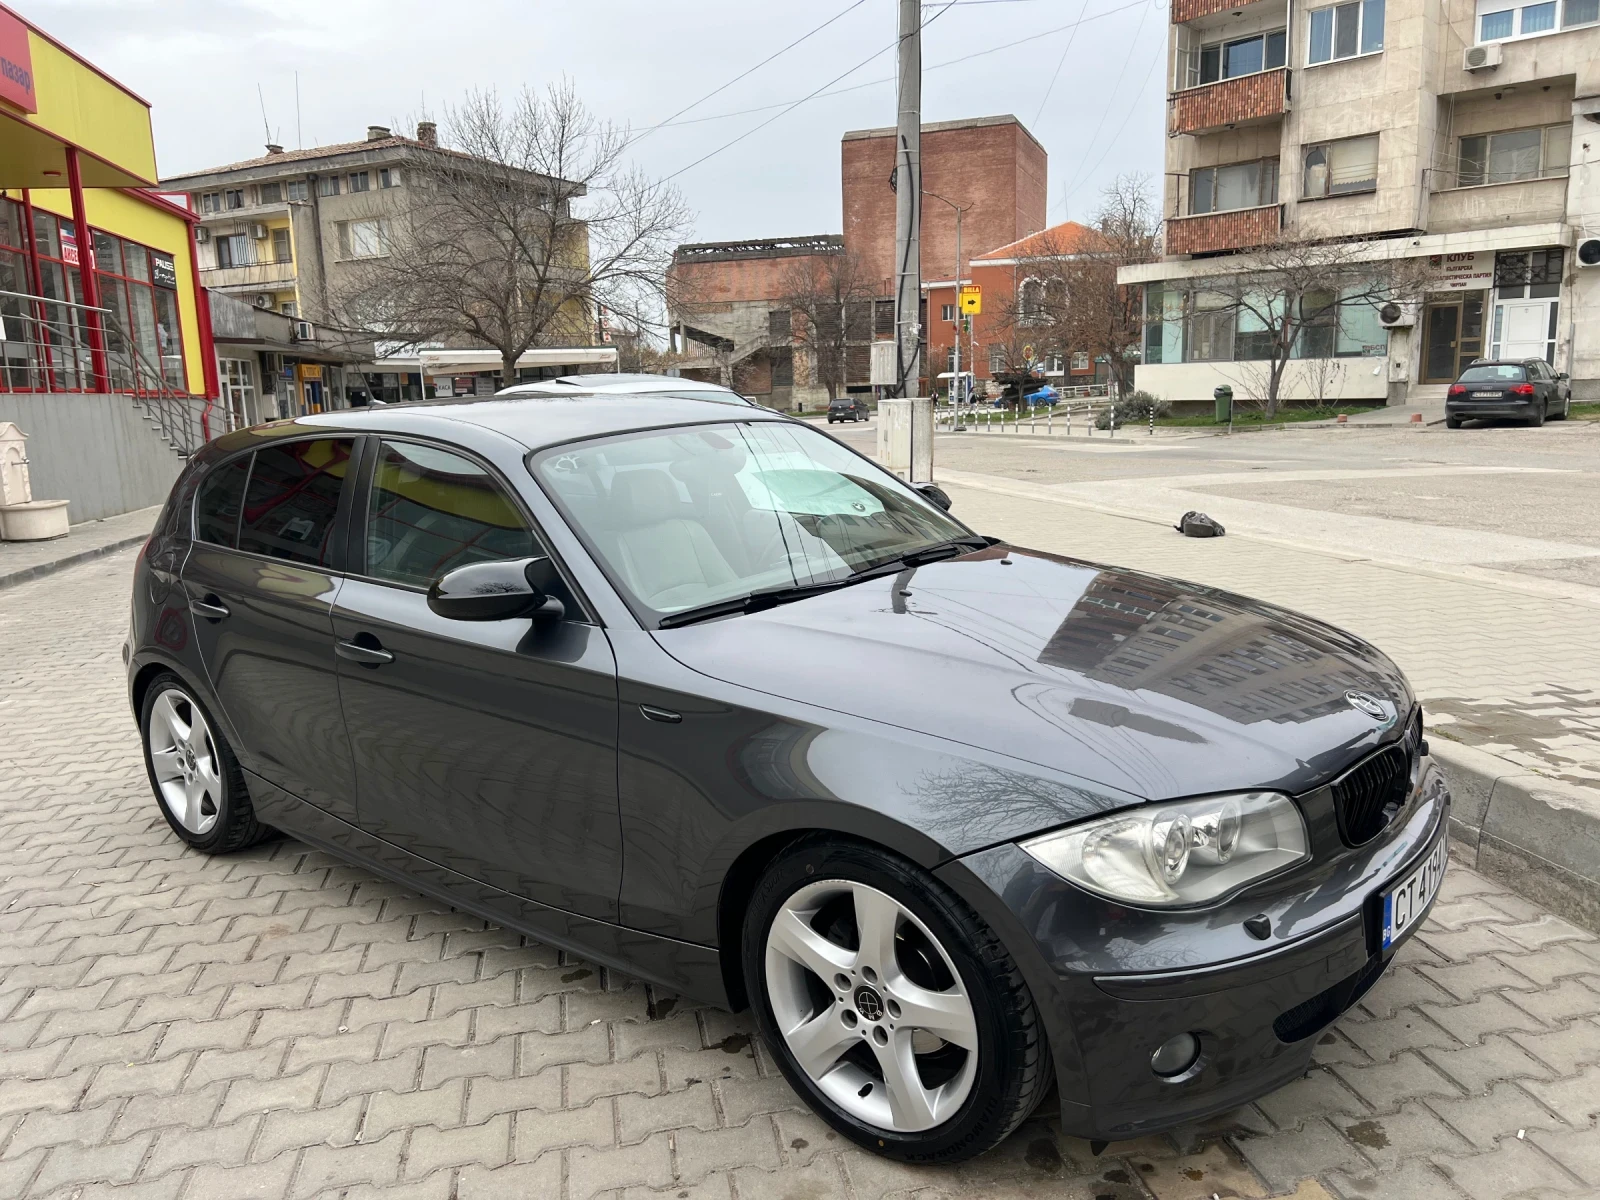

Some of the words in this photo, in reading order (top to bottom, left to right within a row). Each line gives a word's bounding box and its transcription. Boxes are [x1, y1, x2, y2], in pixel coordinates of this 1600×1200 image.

[1446, 252, 1475, 262] КЛУБ
[1395, 876, 1417, 930] CT
[1383, 925, 1391, 941] BG
